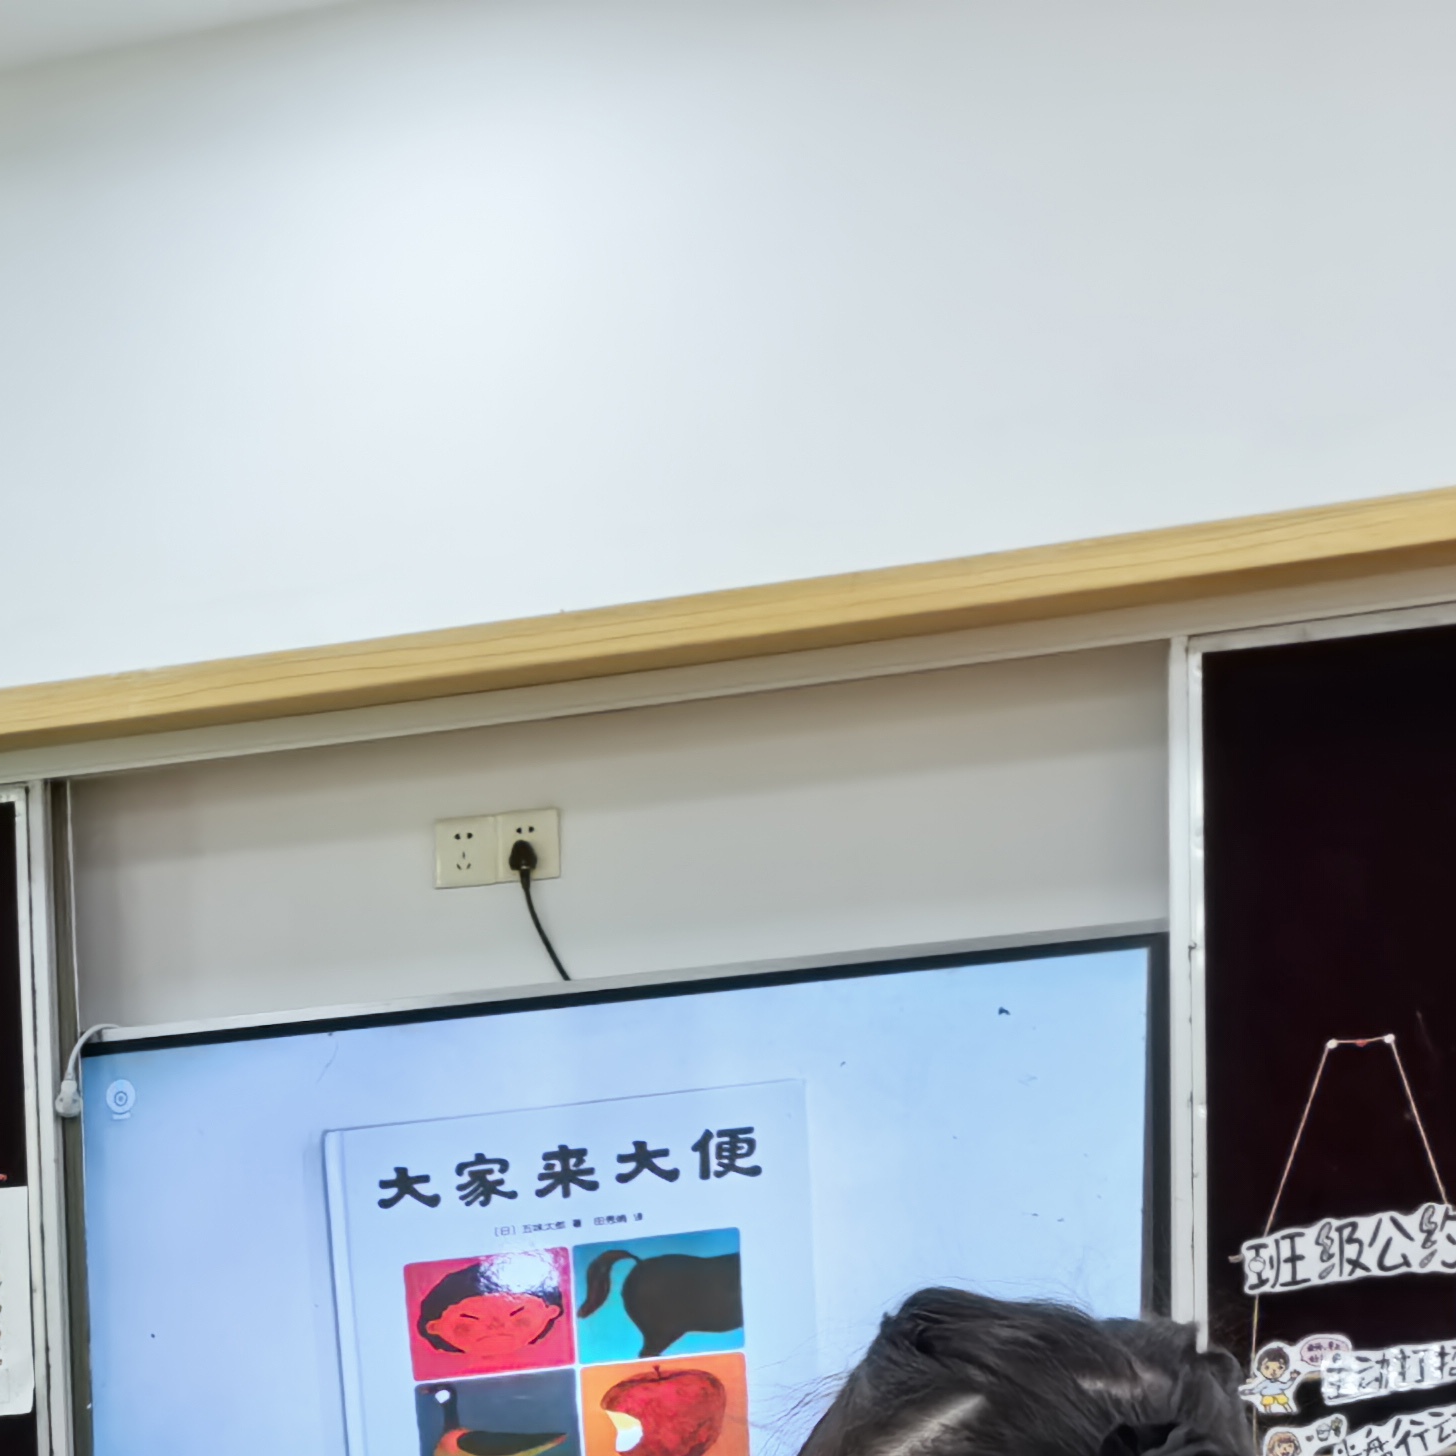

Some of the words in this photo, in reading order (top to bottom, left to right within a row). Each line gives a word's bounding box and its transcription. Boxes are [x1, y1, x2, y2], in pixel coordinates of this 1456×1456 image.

[377, 1126, 762, 1209] 大家来大便
